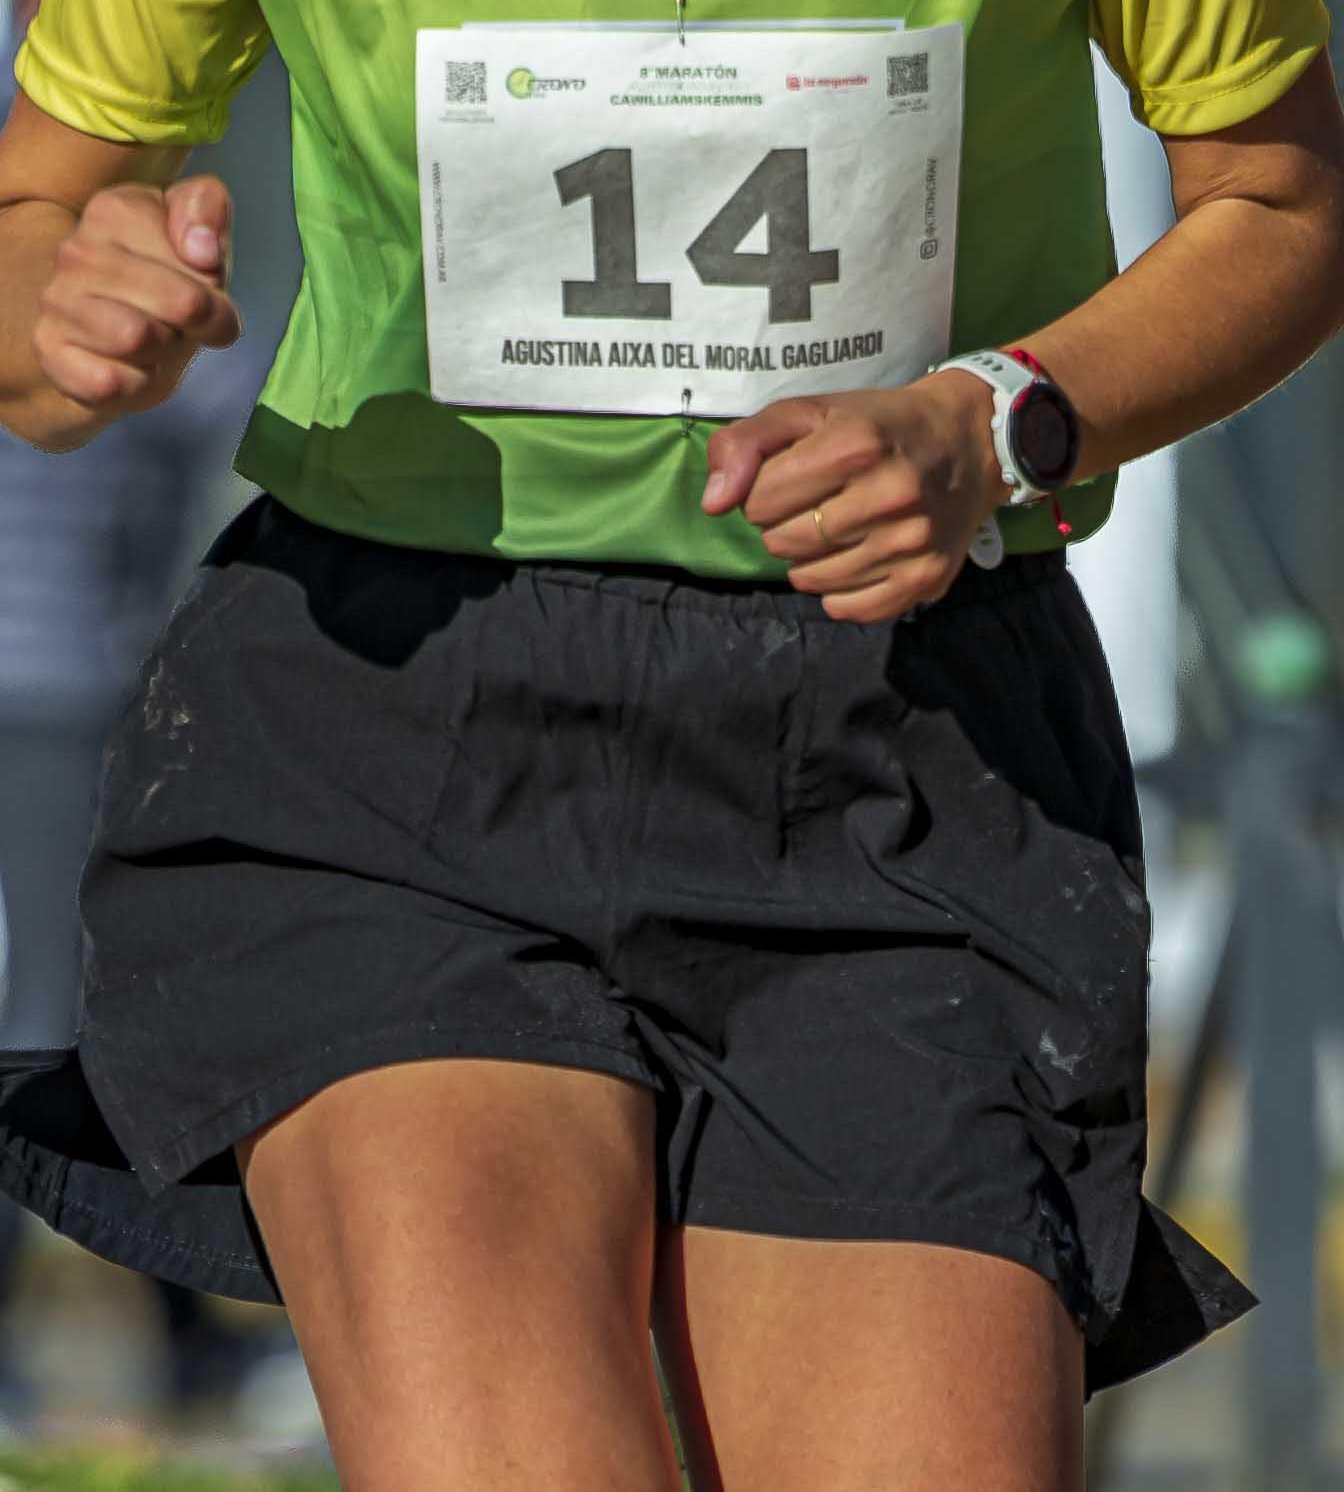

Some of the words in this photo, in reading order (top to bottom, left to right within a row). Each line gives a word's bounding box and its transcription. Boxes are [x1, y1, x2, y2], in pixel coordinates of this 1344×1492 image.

[656, 63, 738, 80] MARATÓN
[553, 147, 840, 325] 14
[500, 339, 604, 368] AGUSTINA
[607, 341, 657, 369] AIXA
[661, 343, 701, 371] DEL
[705, 344, 777, 372] MORAL
[781, 330, 885, 371] GAGLIARDI
